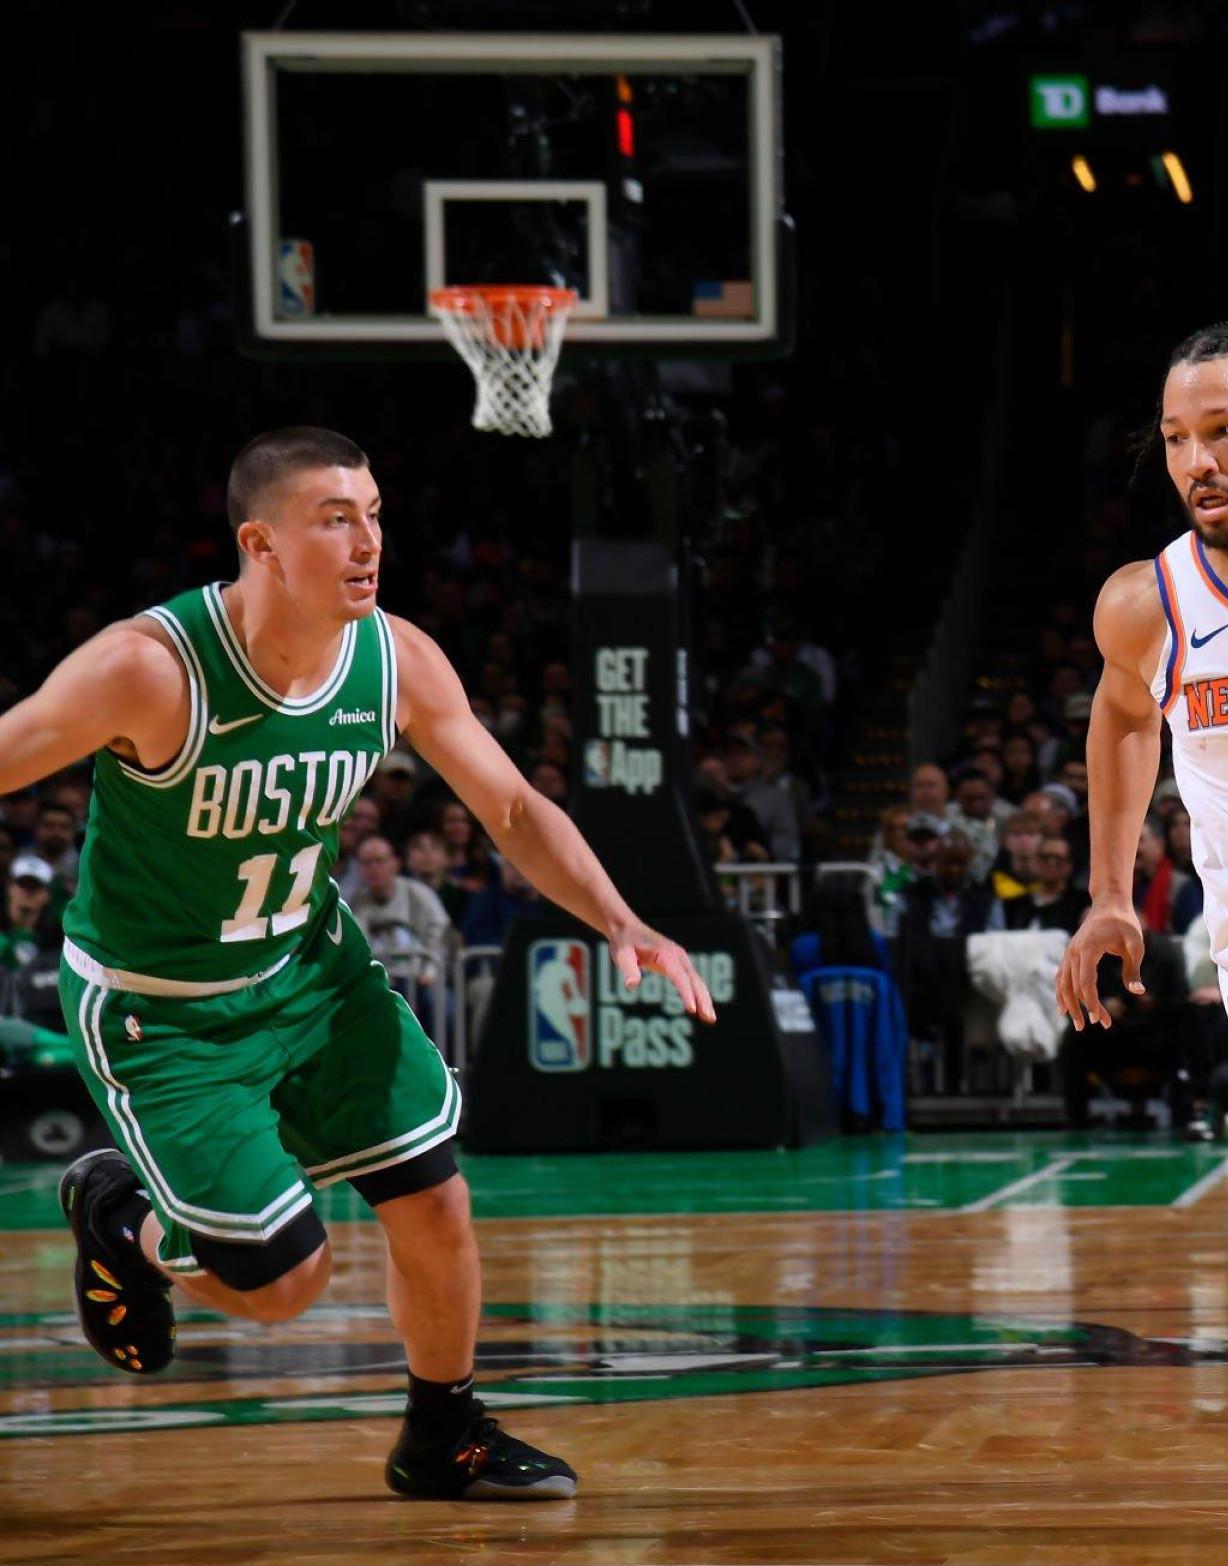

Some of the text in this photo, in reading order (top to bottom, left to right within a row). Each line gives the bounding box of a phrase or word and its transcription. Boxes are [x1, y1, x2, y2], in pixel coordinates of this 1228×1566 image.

[1037, 82, 1085, 119] TD
[594, 646, 650, 692] GET
[329, 707, 376, 726] Amica
[595, 693, 652, 739] THE
[610, 739, 664, 796] App
[186, 750, 381, 840] BOSTON
[220, 843, 324, 943] 11
[597, 1005, 695, 1070] Pass
